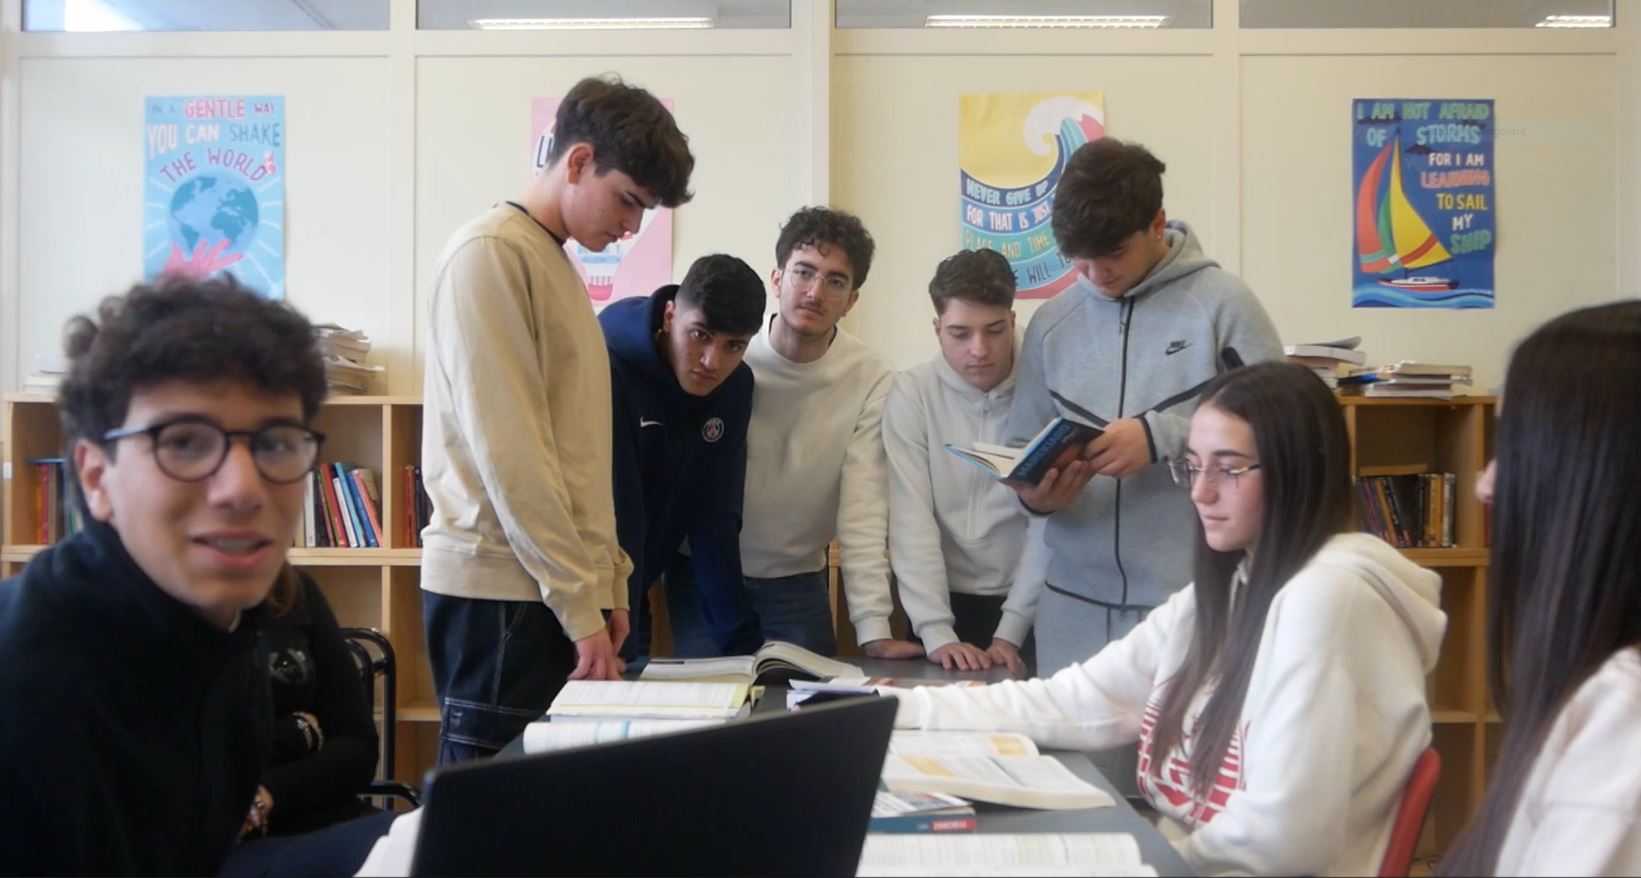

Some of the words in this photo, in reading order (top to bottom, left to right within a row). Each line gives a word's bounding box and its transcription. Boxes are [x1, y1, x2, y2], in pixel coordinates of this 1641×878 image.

[184, 98, 246, 119] GENTLE
[253, 102, 276, 114] WAY
[1357, 103, 1364, 120] I
[1371, 103, 1395, 120] AM
[1402, 102, 1431, 120] NOT
[1439, 103, 1490, 120] AFRAID
[147, 123, 178, 159] YOU
[185, 123, 219, 145] CAN
[229, 123, 281, 147] SHAKE
[1366, 127, 1387, 147] OF
[1416, 124, 1481, 146] STORMS
[160, 151, 197, 183] THE
[207, 147, 268, 182] WORLD
[1429, 152, 1452, 166] FOR
[1455, 153, 1461, 166] I
[1466, 152, 1485, 166] AM
[1420, 169, 1490, 189] LEARNING
[966, 178, 1000, 205] NEVER
[1006, 187, 1031, 205] GIVE
[1035, 180, 1049, 198] UP
[1436, 193, 1454, 210] TO
[1456, 194, 1488, 210] SAIL
[966, 204, 984, 227] FOR
[989, 211, 1013, 231] THAT
[1019, 210, 1030, 230] IS
[1032, 202, 1050, 223] JUST
[1452, 214, 1474, 231] MY
[1001, 239, 1021, 258] AND
[1450, 230, 1492, 255] SHIP
[1026, 261, 1053, 284] WILL
